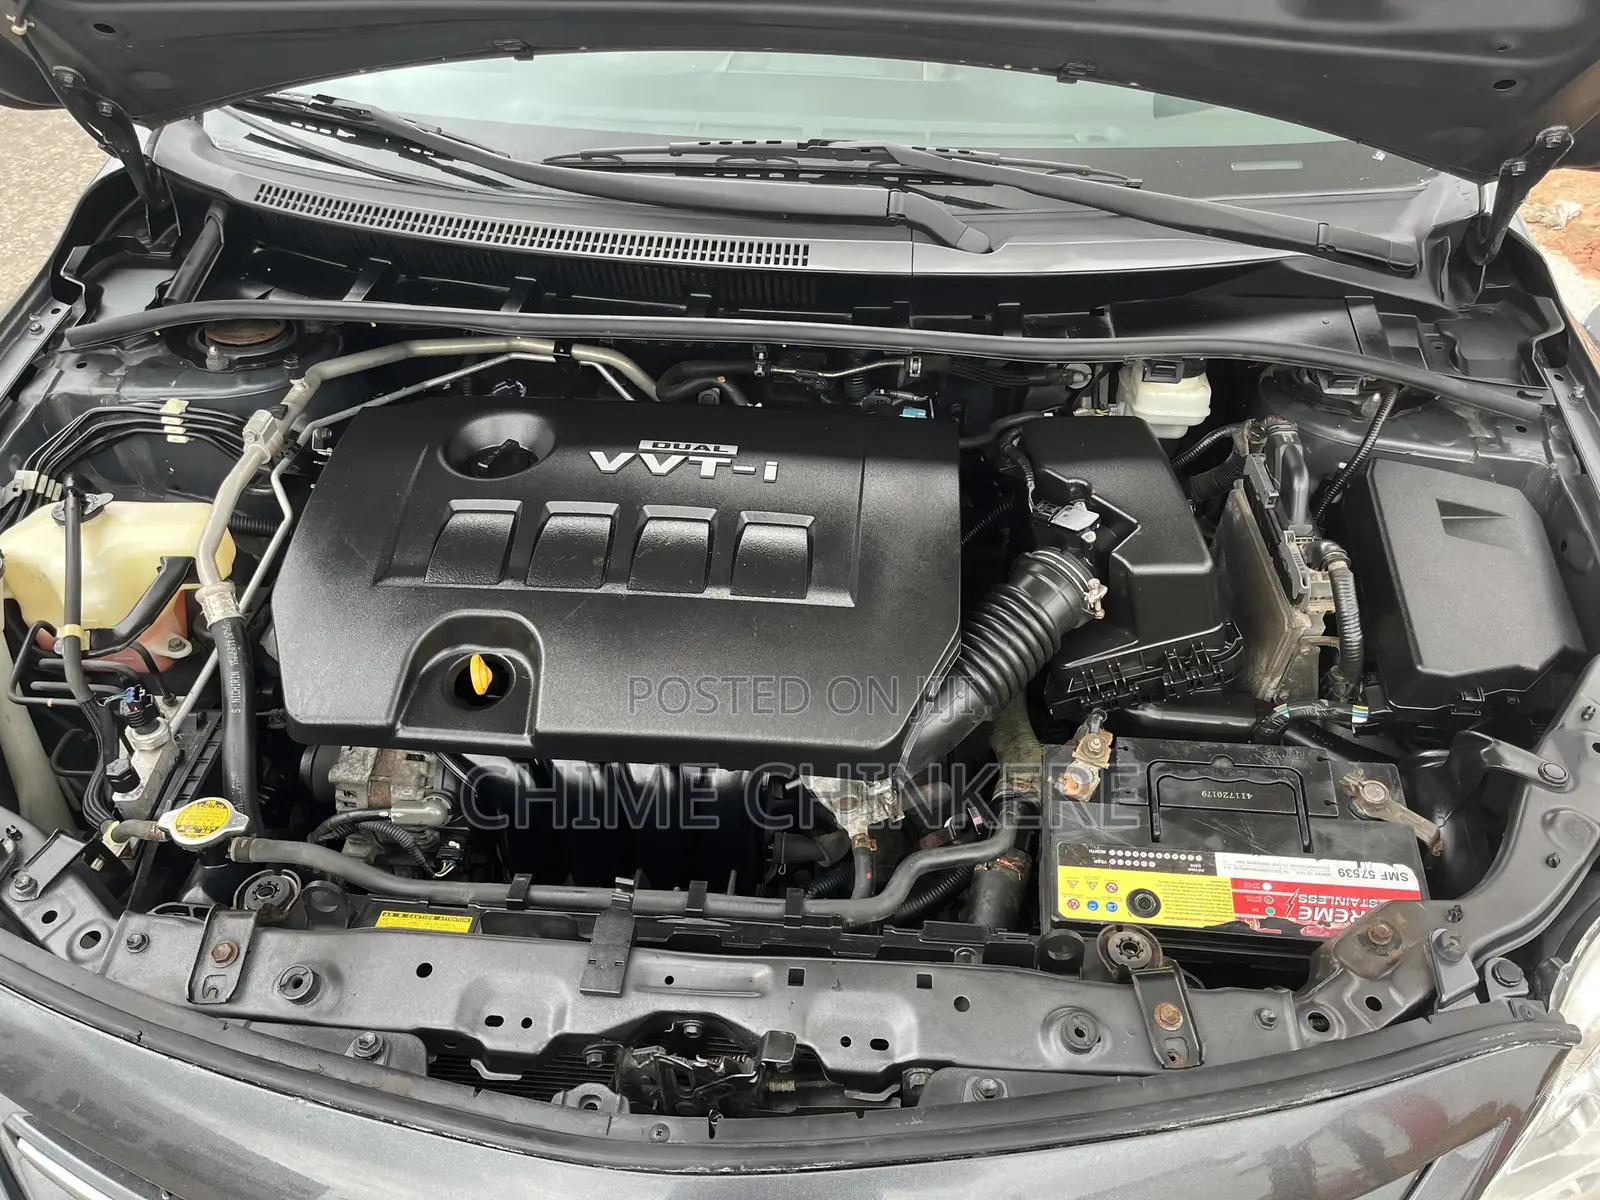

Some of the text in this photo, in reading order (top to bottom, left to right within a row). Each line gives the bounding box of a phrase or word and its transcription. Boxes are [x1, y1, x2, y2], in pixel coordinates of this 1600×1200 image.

[652, 441, 729, 453] DUAL
[588, 450, 779, 483] VVT-i
[1337, 868, 1376, 880] 57539
[1380, 870, 1409, 882] SMF
[1297, 893, 1379, 908] STAINLESS
[1297, 905, 1366, 923] REME
